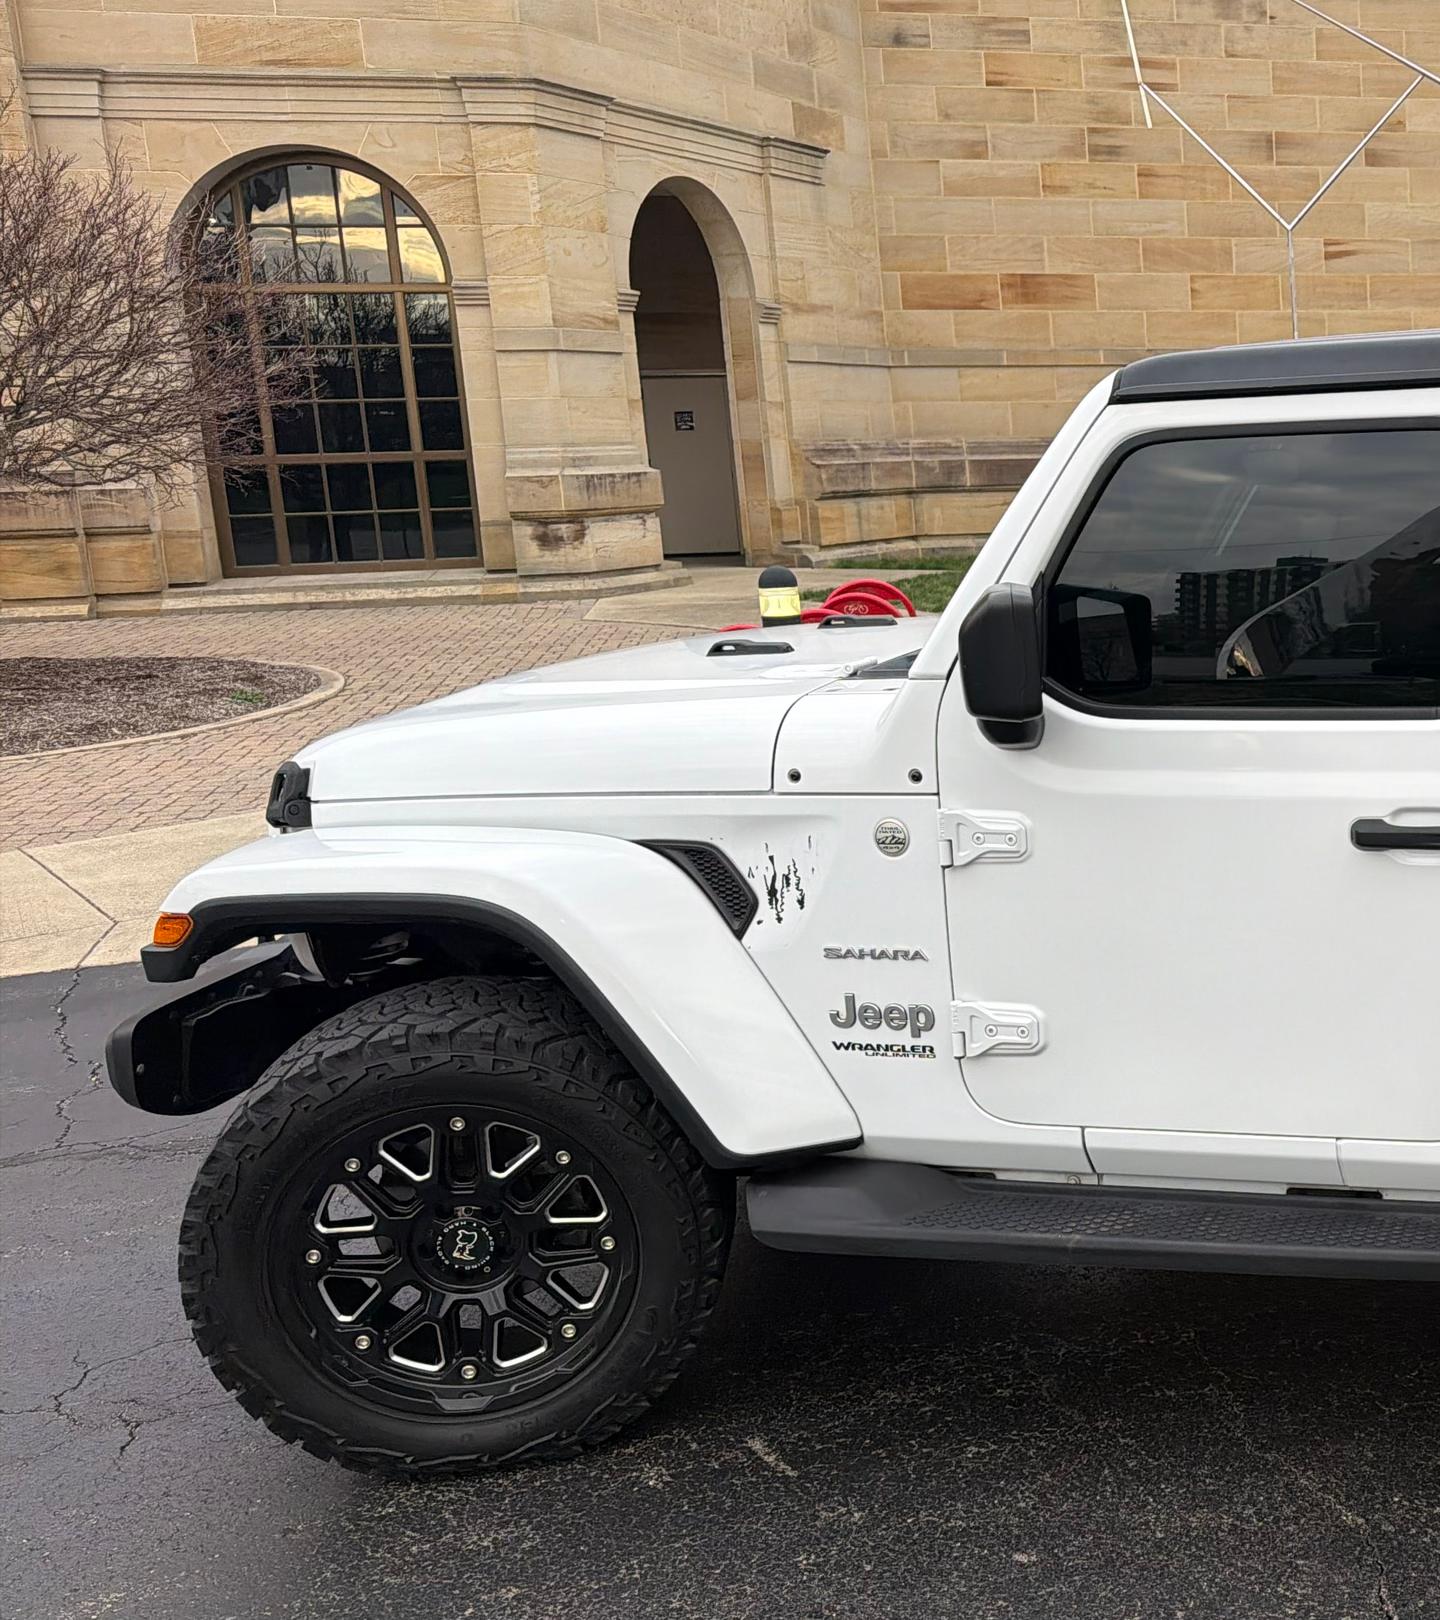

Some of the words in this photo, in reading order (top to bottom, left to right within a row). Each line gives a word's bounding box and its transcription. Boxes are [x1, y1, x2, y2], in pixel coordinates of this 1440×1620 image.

[823, 946, 930, 961] SAHARA
[828, 992, 935, 1038] Jeep
[832, 1041, 935, 1054] WRANGLER
[864, 1051, 936, 1059] UNLIMITED
